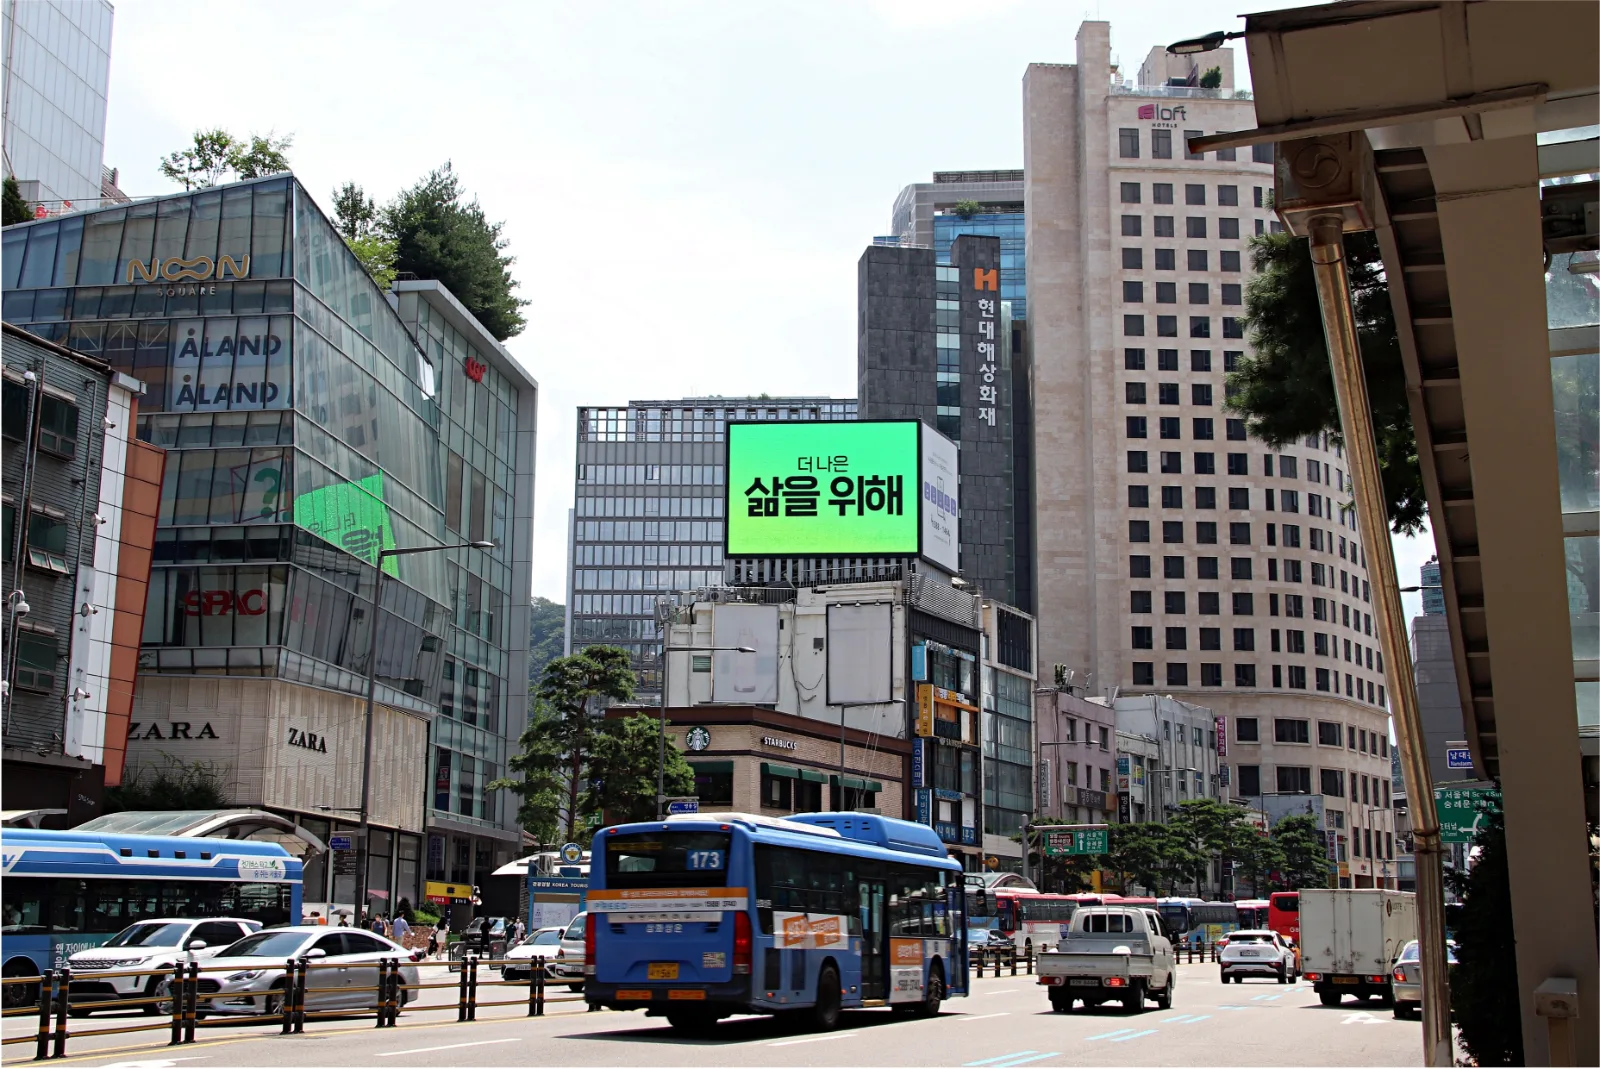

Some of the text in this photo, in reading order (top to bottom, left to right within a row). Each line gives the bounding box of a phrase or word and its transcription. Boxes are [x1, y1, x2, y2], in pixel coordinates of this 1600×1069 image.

[156, 286, 217, 297] SQUARE
[977, 298, 998, 427] 현대해상화재
[797, 455, 849, 473] 더 나은
[744, 475, 821, 517] 삶을
[828, 474, 904, 517] 위해
[127, 722, 220, 740] ZARA
[288, 727, 328, 754] ZARA
[764, 736, 798, 750] STARBUCKS
[1445, 791, 1470, 799] 서울역
[1444, 800, 1471, 809] 숭례문
[690, 851, 720, 869] 173
